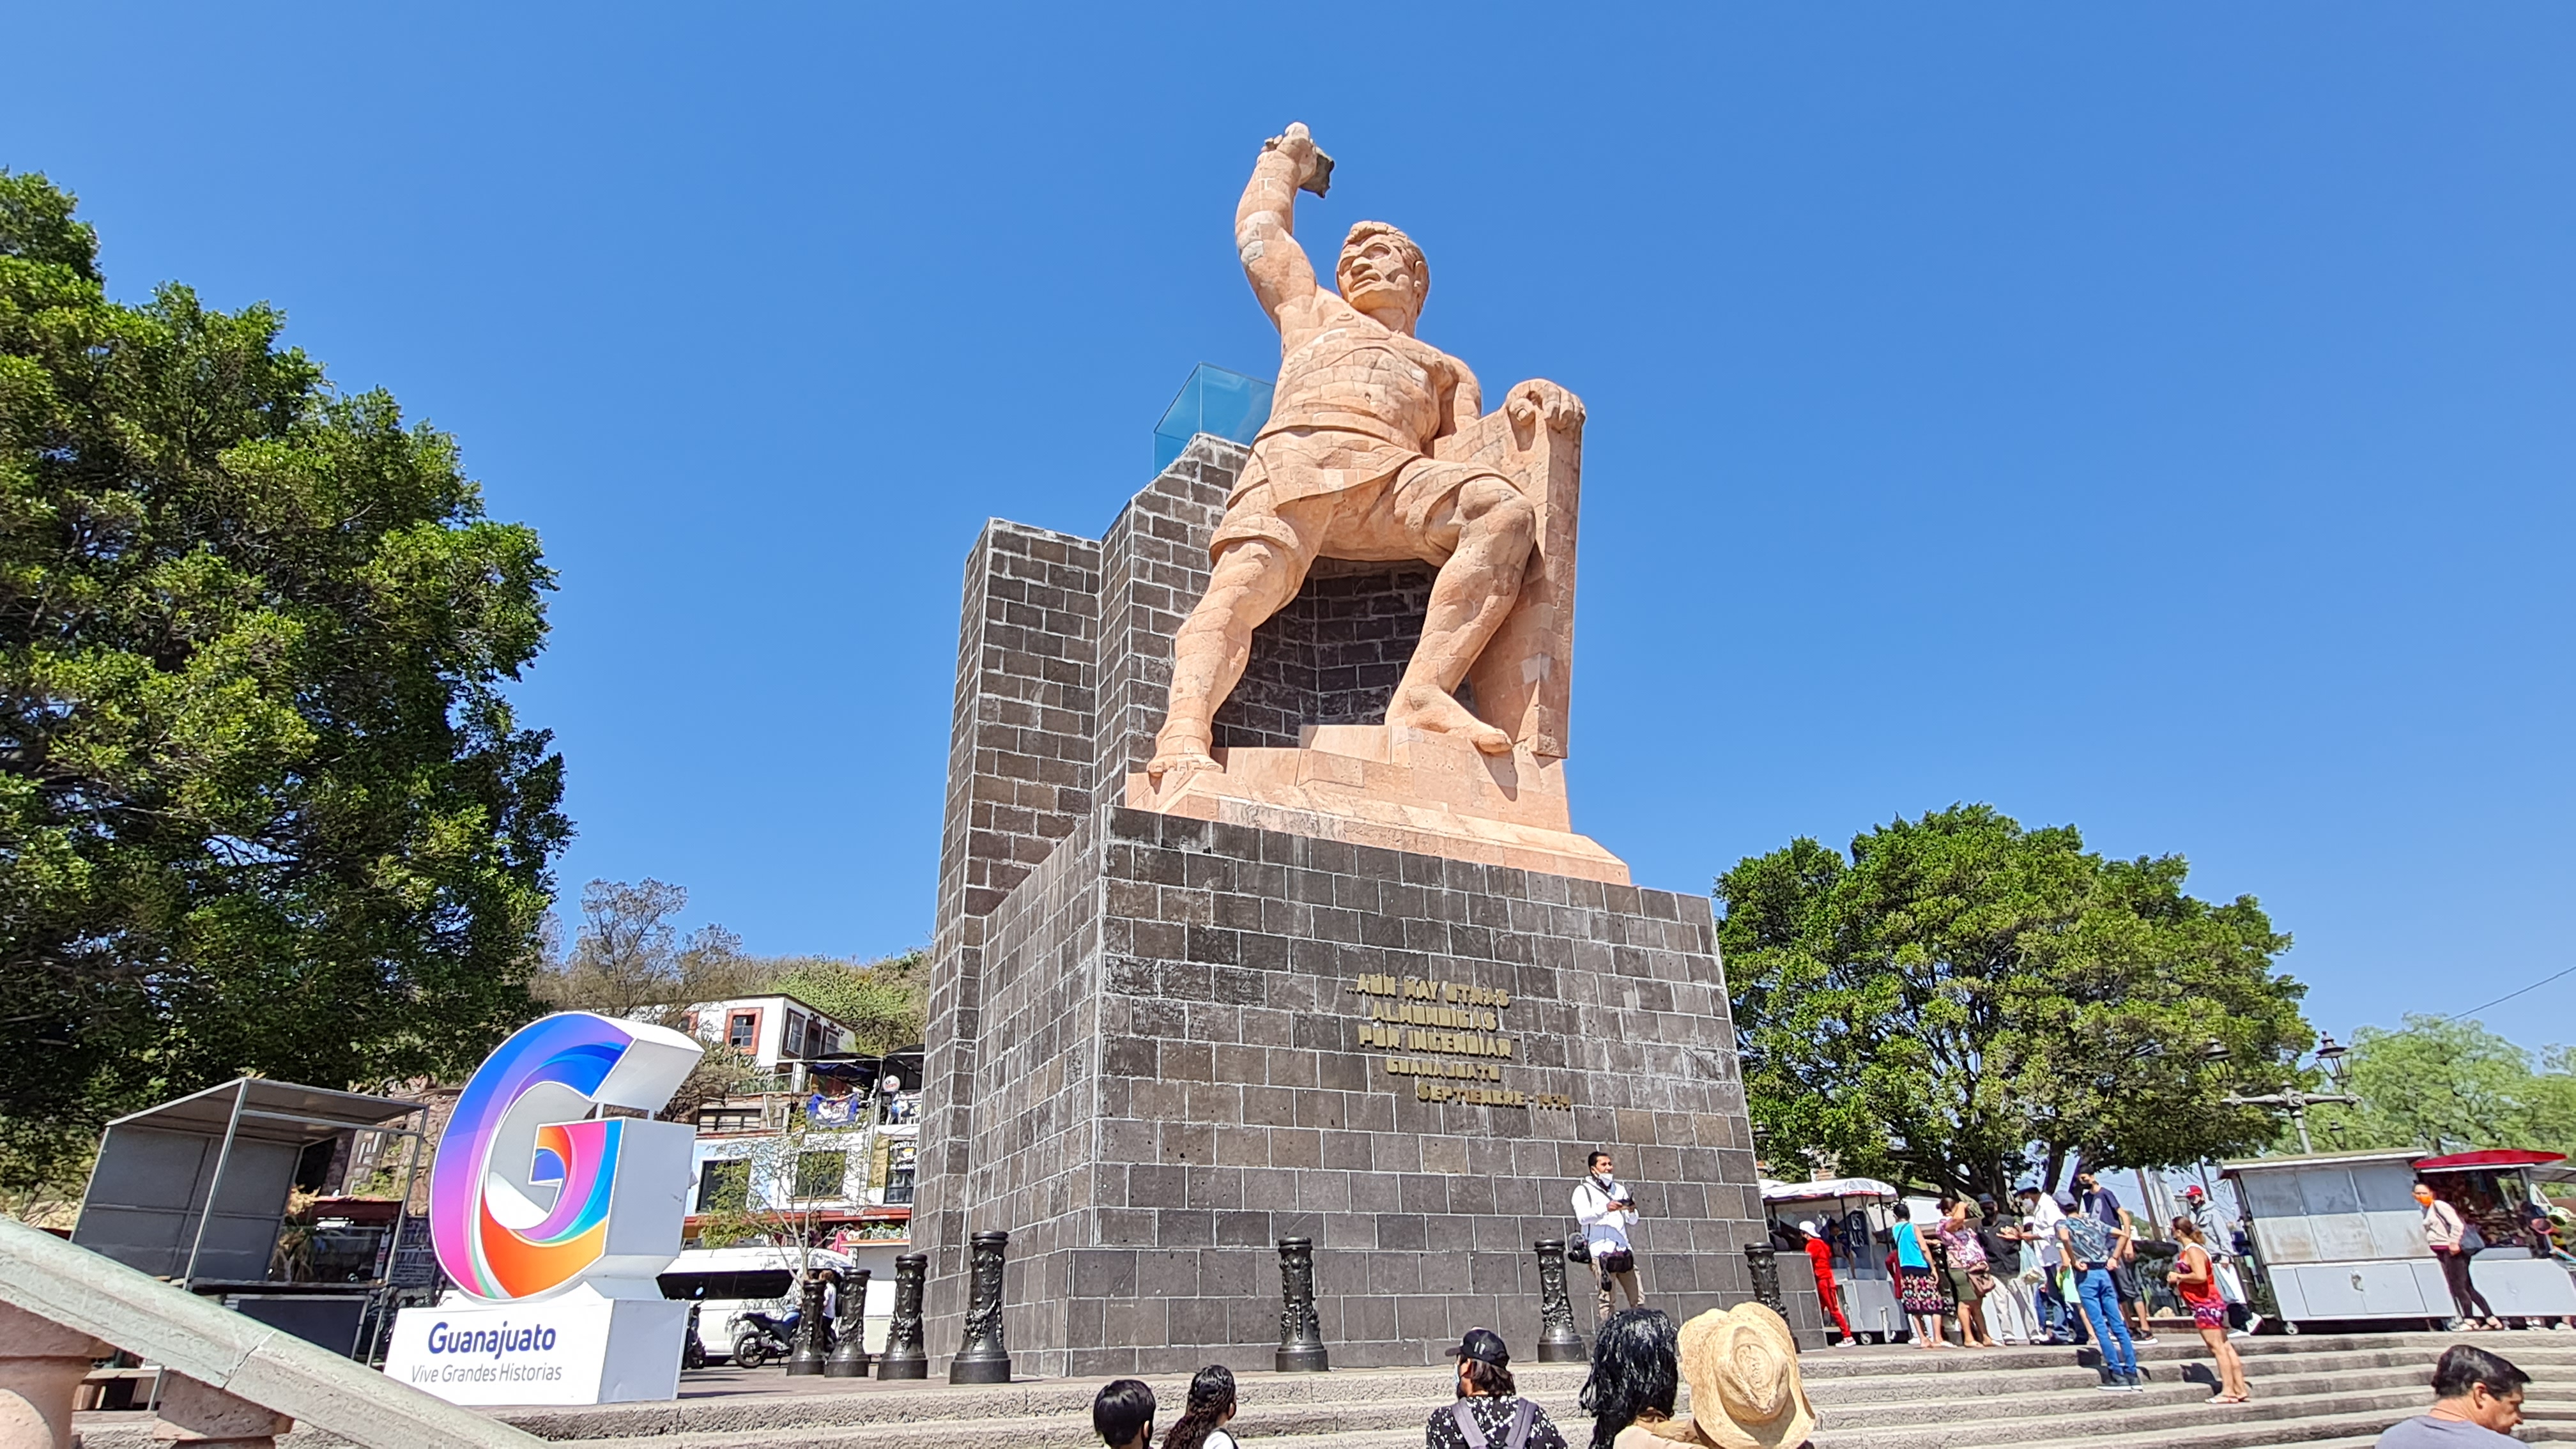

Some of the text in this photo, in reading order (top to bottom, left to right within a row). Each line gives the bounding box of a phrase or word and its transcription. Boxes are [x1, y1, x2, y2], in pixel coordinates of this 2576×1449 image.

[1358, 1024, 1401, 1051] POR
[1387, 1057, 1501, 1083] GUANAJUATO
[428, 1321, 556, 1360] Guanajuato
[412, 1362, 562, 1383] Vive Grandes Historias
